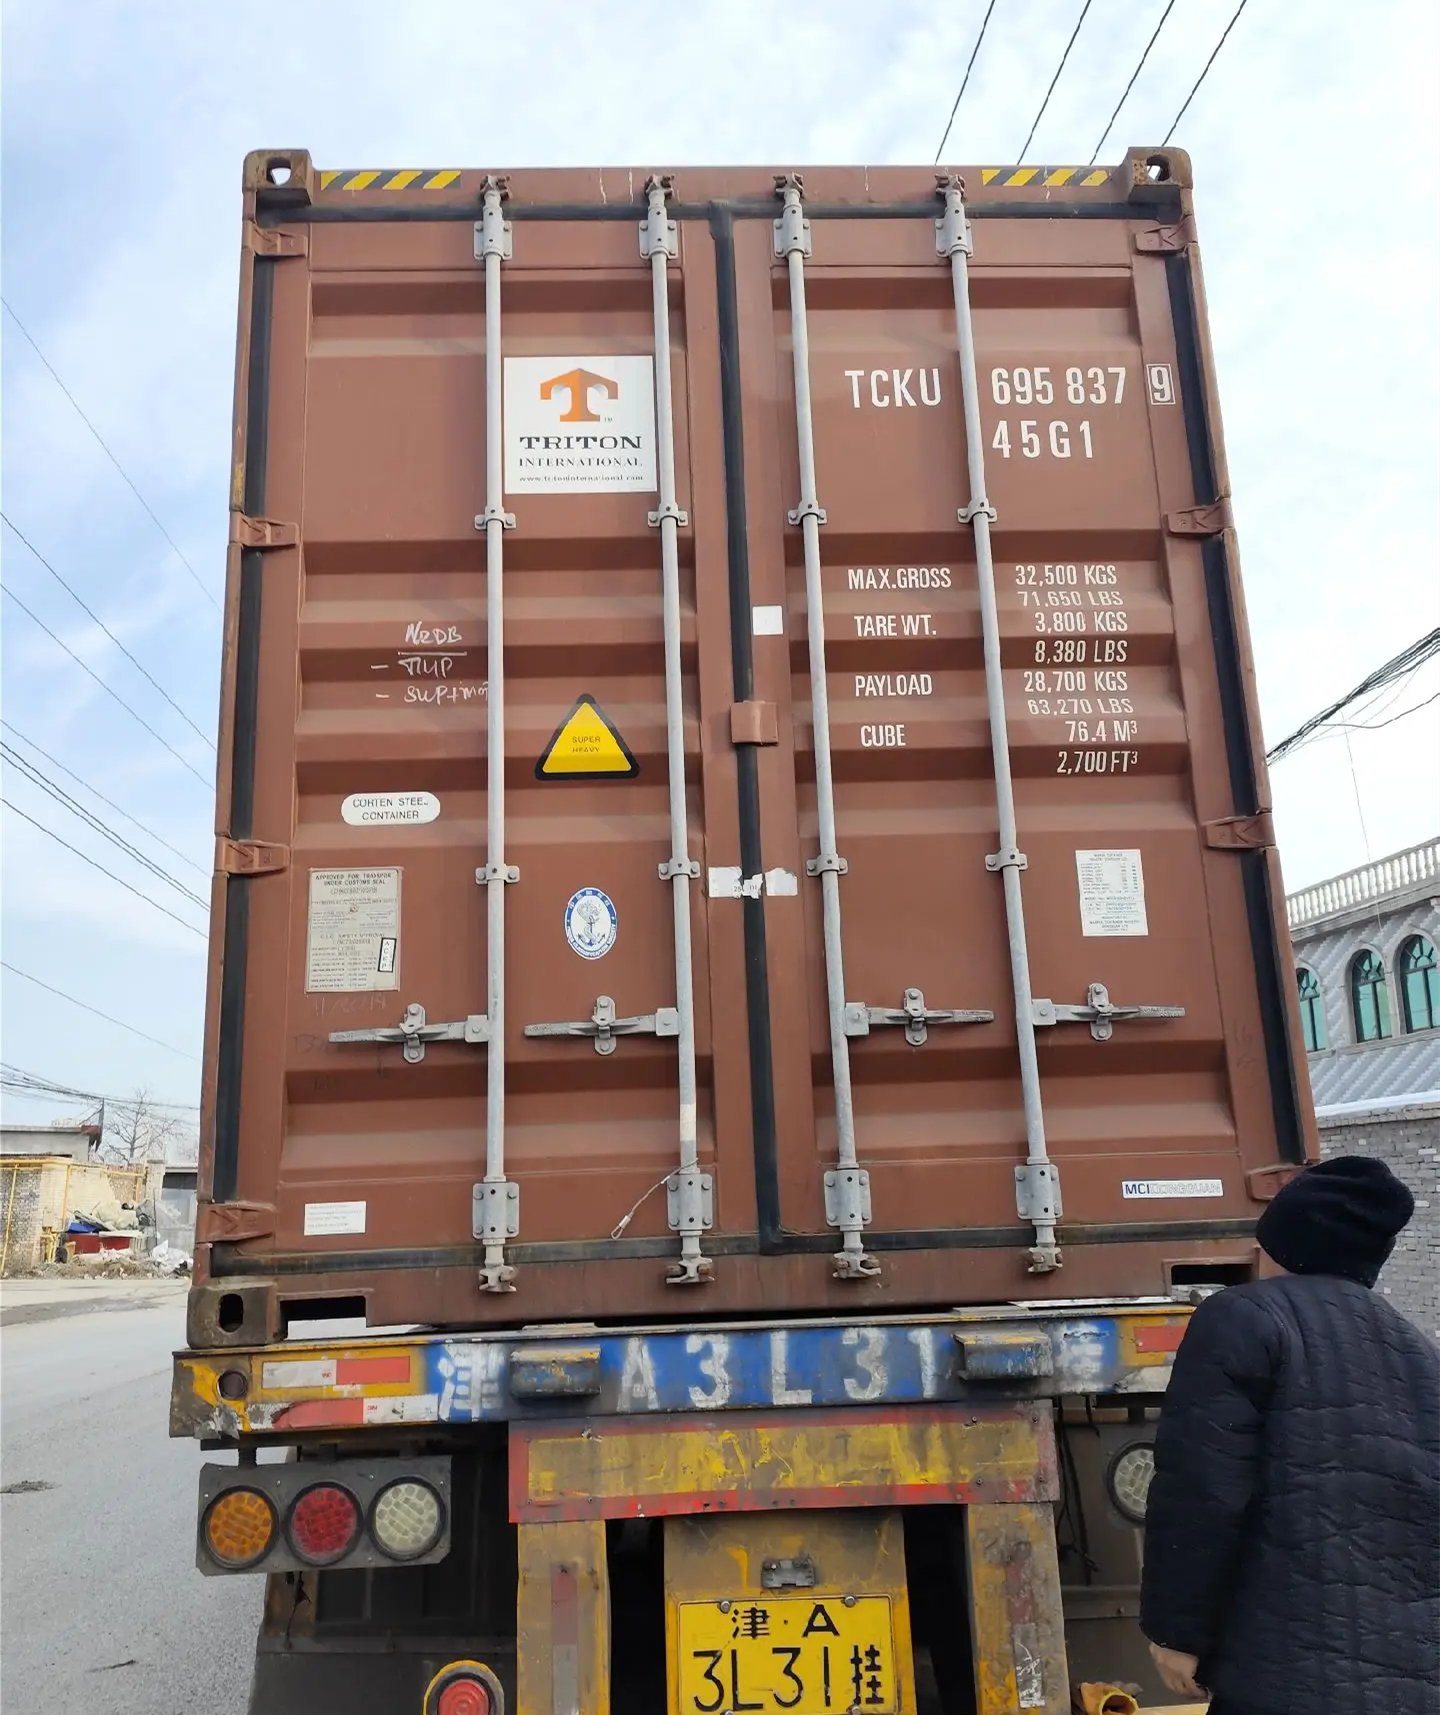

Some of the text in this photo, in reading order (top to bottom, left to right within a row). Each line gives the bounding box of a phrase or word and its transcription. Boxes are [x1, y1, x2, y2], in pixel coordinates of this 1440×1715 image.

[844, 366, 1172, 408] TCKU 695 837 9
[519, 436, 642, 450] TRITON
[992, 420, 1093, 459] 45G1
[519, 456, 643, 467] INTERNATIONAL
[847, 564, 1118, 590] MAX.GROSS 32,500 KGS
[1087, 590, 1124, 606] LBS
[854, 611, 1128, 637] TARE WT. 3,800 KGS
[1034, 640, 1128, 664] 8,380 LBS
[854, 671, 1128, 697] PAYLOAD 28,700 KGS
[1096, 698, 1134, 714] LBS
[572, 735, 601, 744] SUPER
[860, 724, 906, 747] CUBE
[1064, 720, 1107, 743] 76.4
[1056, 751, 1107, 775] 2,700
[352, 799, 393, 808] CORTEN
[362, 810, 419, 820] CONTAINER
[1125, 1183, 1150, 1195] MCI
